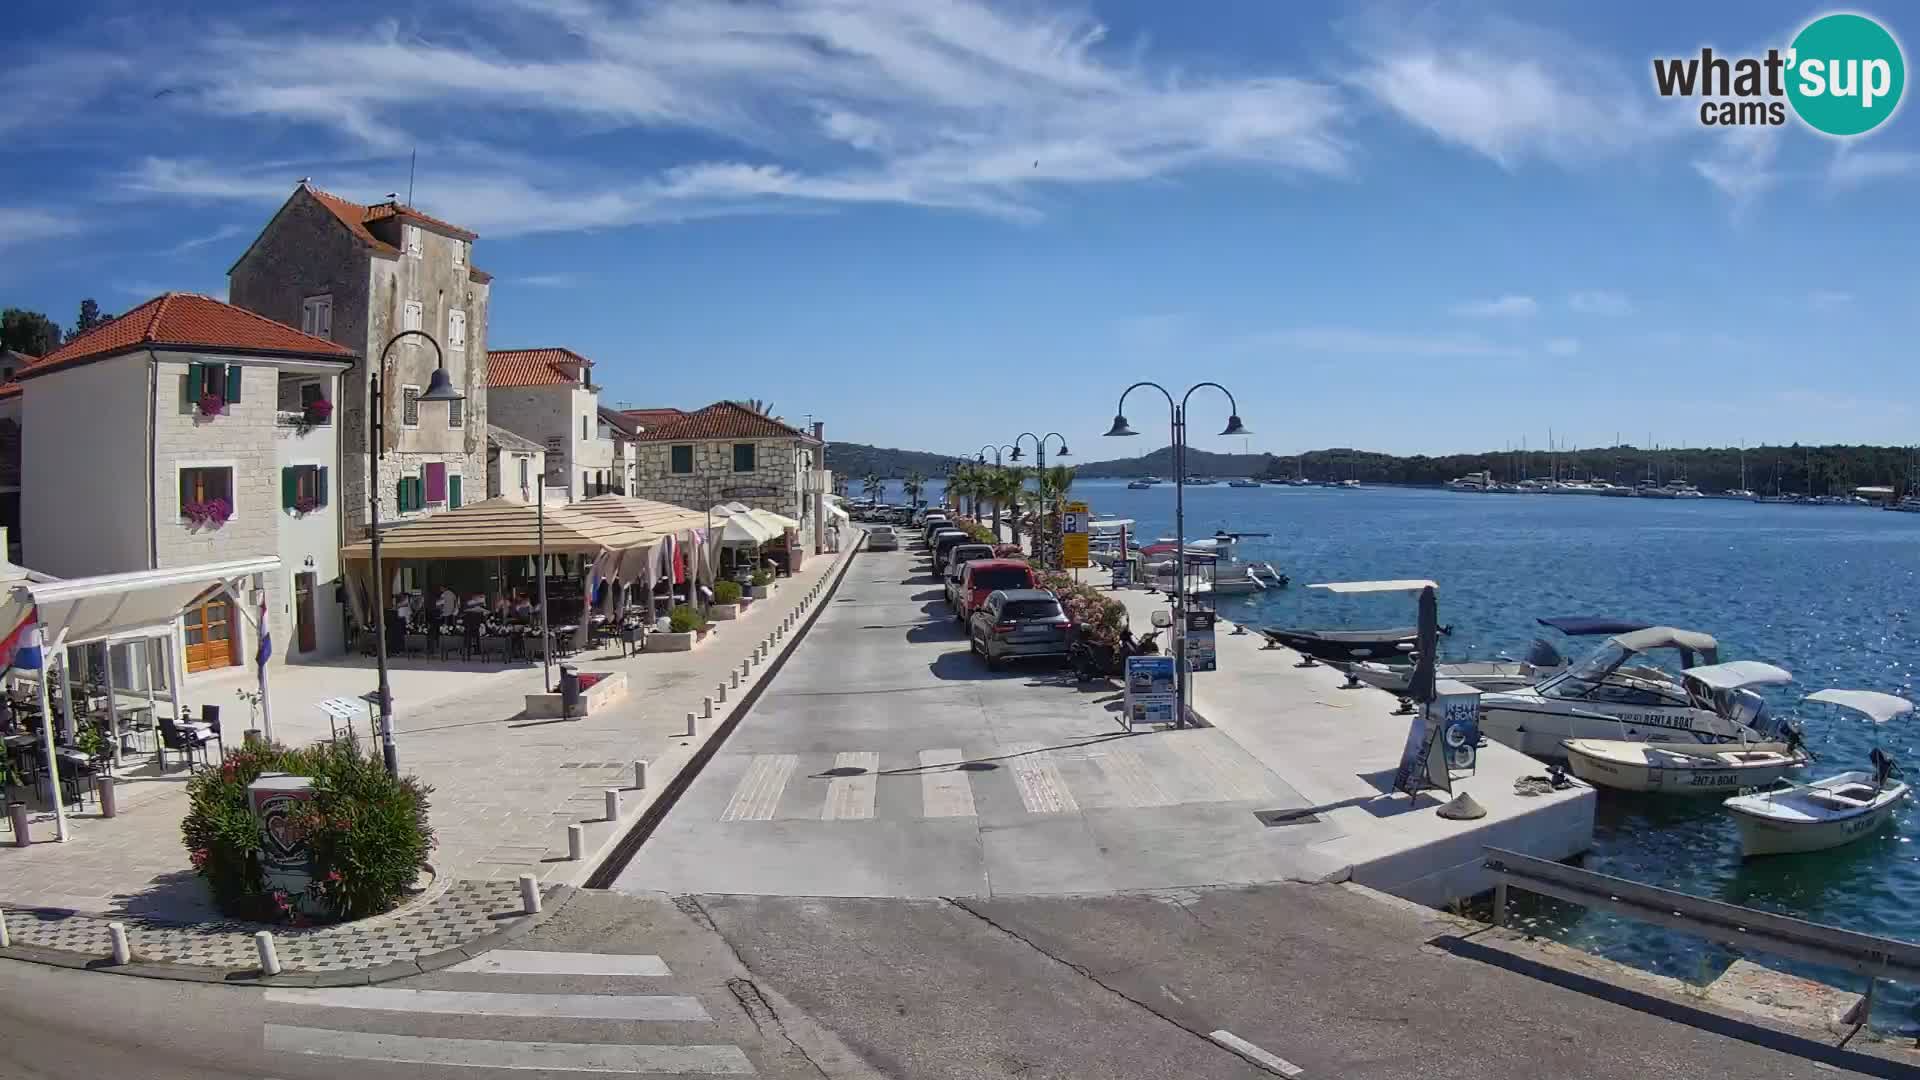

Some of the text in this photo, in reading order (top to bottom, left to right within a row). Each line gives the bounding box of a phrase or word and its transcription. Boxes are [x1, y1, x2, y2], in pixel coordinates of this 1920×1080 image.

[1065, 515, 1075, 531] P
[1447, 703, 1477, 712] RENT
[1454, 711, 1478, 720] BOAT
[1644, 714, 1665, 726] RENT
[1674, 716, 1693, 728] BOAT
